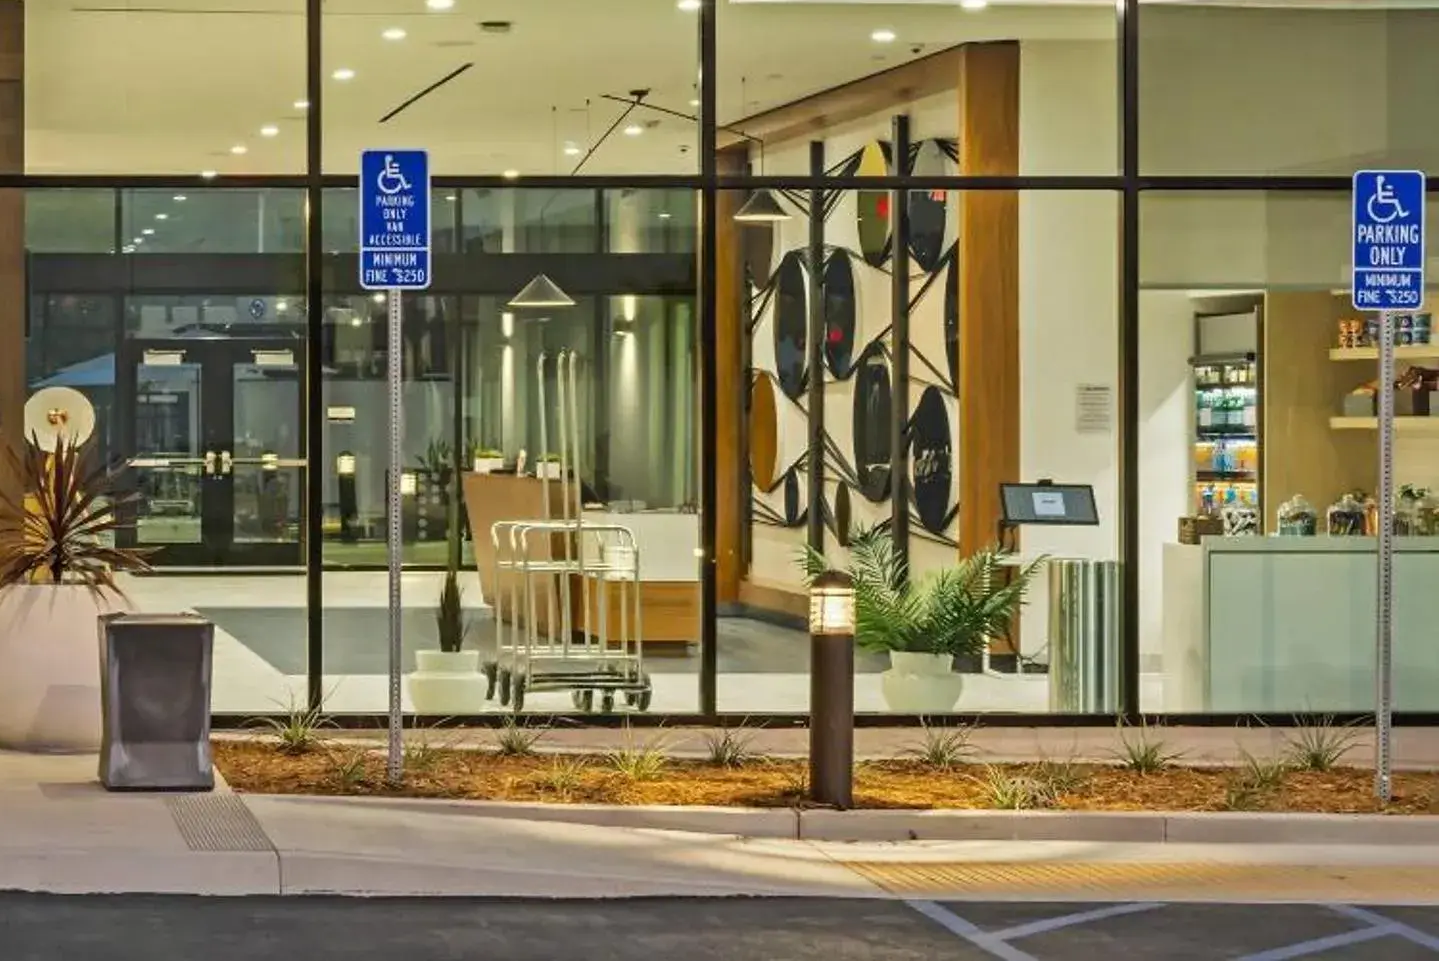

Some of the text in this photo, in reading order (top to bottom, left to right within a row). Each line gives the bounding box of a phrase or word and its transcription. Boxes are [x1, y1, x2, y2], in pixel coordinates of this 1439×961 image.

[375, 195, 415, 208] PARKING
[383, 208, 408, 221] ONLY
[386, 221, 404, 233] VAN
[1357, 224, 1420, 244] PARKING
[369, 233, 422, 246] ACCESSIBLE
[372, 252, 417, 267] MINIMUM
[1369, 246, 1407, 266] ONLY
[365, 269, 425, 283] FINE $250
[1365, 273, 1412, 287] MINIMUM
[1357, 290, 1420, 304] FINE $250
